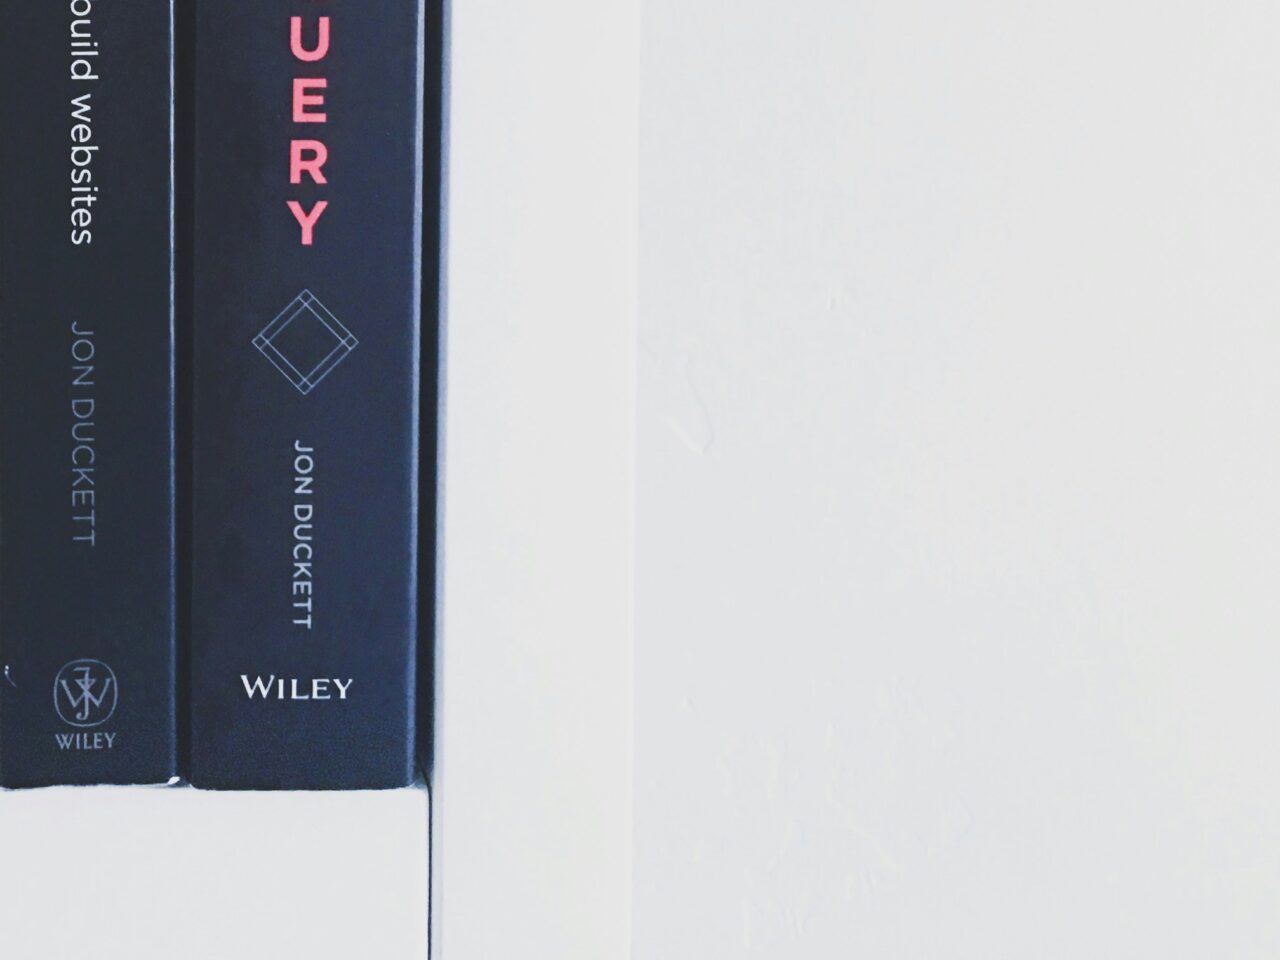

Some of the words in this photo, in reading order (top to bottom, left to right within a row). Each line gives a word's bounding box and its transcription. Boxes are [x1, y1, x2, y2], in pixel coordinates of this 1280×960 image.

[69, 93, 100, 247] websites
[70, 320, 96, 387] JON
[70, 398, 97, 548] DUCKETT
[293, 439, 315, 495] JON
[292, 504, 314, 630] DUCKETT
[54, 732, 117, 751] WILEY
